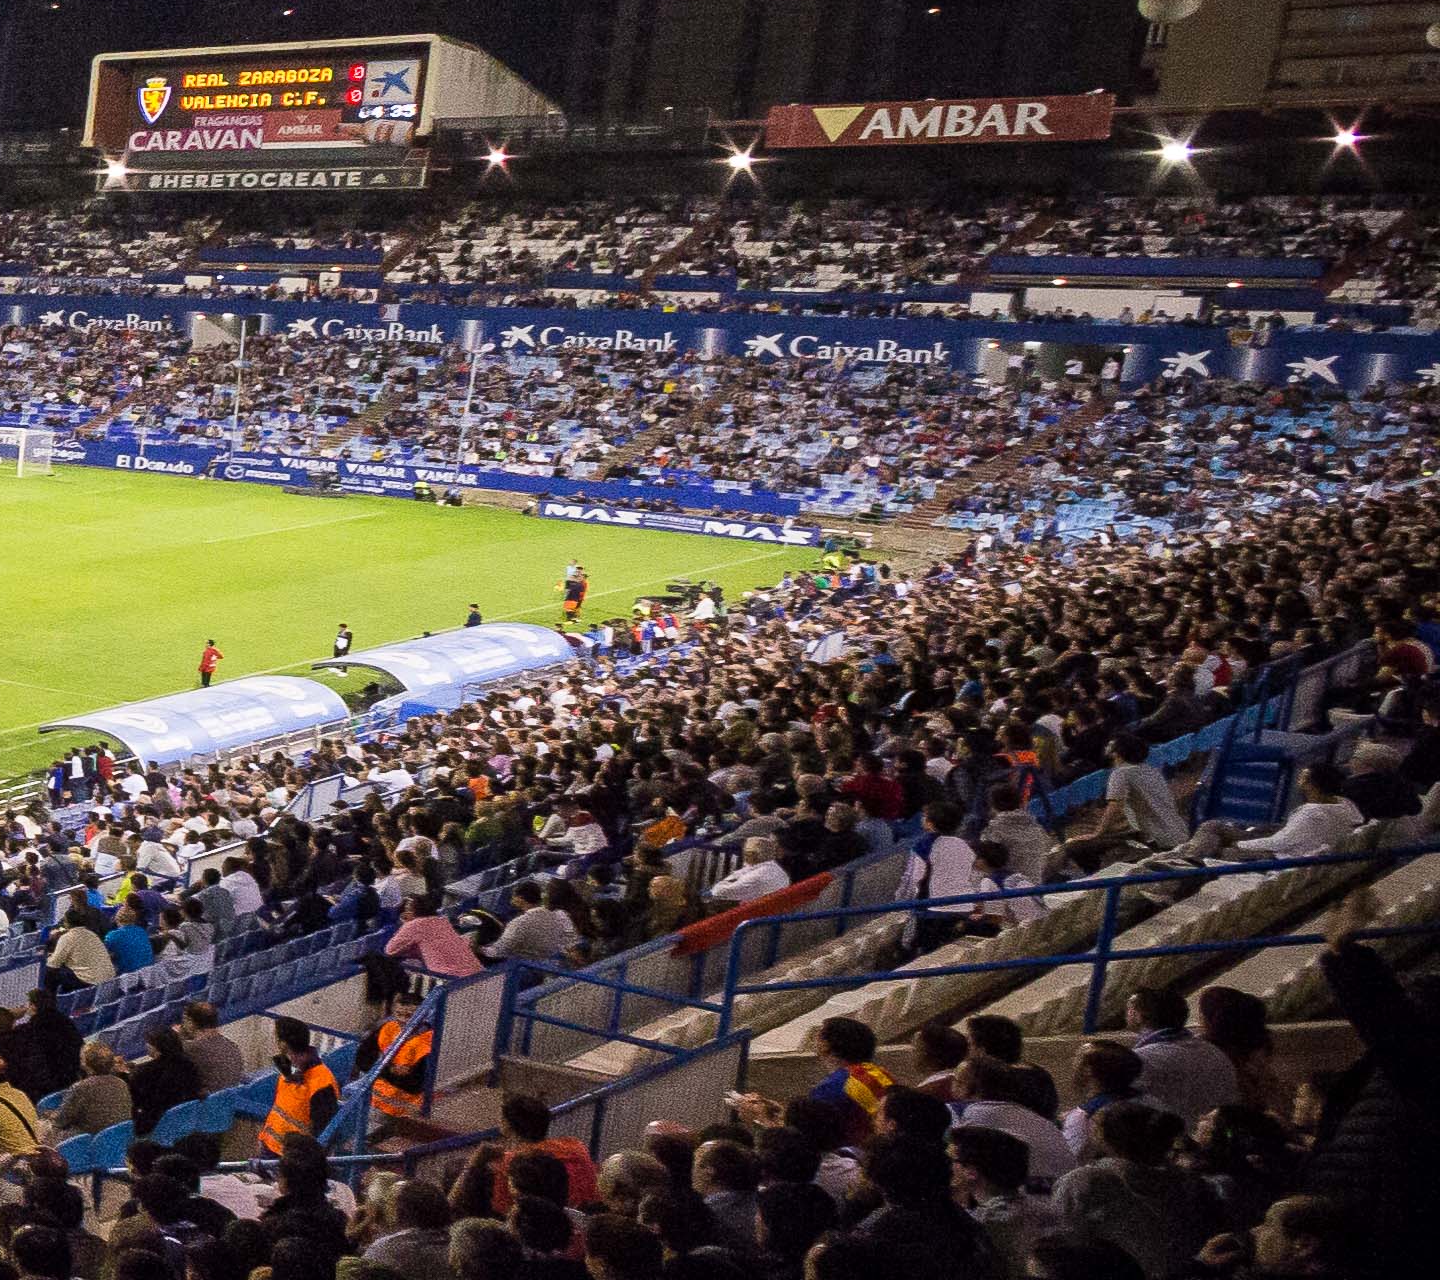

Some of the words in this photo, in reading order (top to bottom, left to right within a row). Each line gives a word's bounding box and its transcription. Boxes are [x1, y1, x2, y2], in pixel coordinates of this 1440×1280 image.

[184, 73, 229, 89] REAL
[238, 67, 333, 86] ZARAGOZA
[180, 93, 272, 110] VALENCIA
[193, 115, 264, 128] FRAGANCIAS
[276, 124, 324, 137] AMBAR
[858, 102, 1057, 140] AMBAR
[129, 128, 264, 151] CARAVAN
[147, 171, 362, 189] #HERETOCREATE
[320, 319, 445, 345] CaixaBank
[539, 326, 680, 353] CaixaBank
[789, 335, 951, 365] CaixaBank
[354, 465, 406, 479] AMBAR
